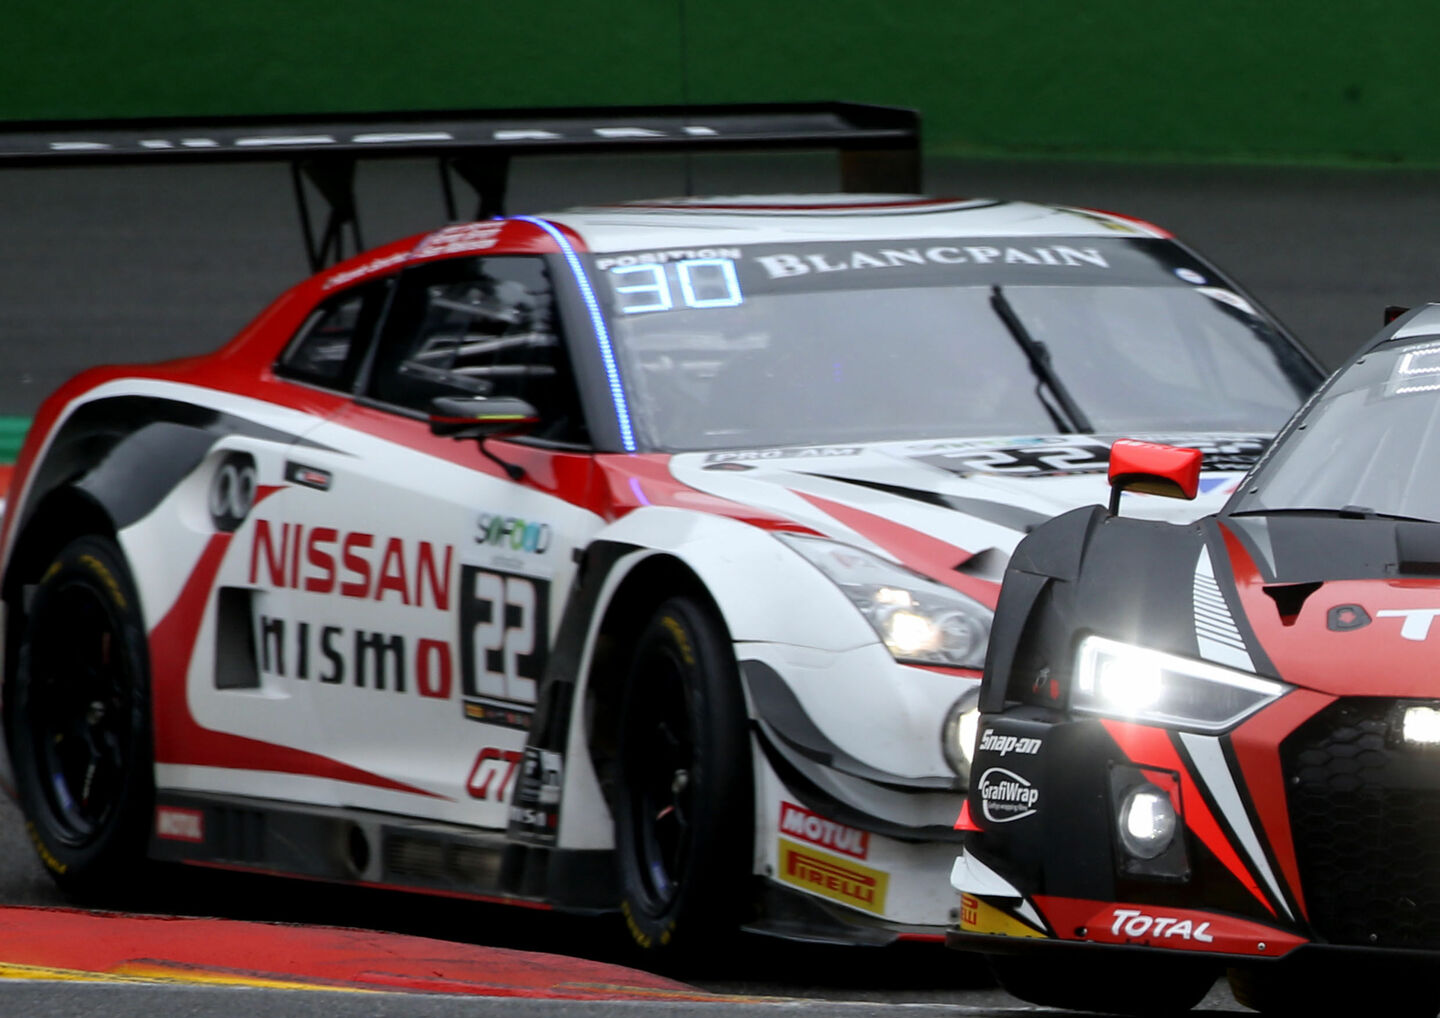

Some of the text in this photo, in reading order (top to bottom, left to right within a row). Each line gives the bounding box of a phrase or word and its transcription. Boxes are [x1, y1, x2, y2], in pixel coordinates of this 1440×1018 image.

[753, 245, 1110, 280] BLANCPAIN
[610, 258, 743, 314] 30
[248, 519, 454, 611] NISSAN
[474, 571, 538, 704] 22
[979, 729, 1043, 756] Snap-on
[982, 780, 1039, 808] GrafiWrap
[782, 808, 864, 854] MOTUL
[786, 849, 877, 905] PIRELLI
[1111, 909, 1214, 942] TOTAL
